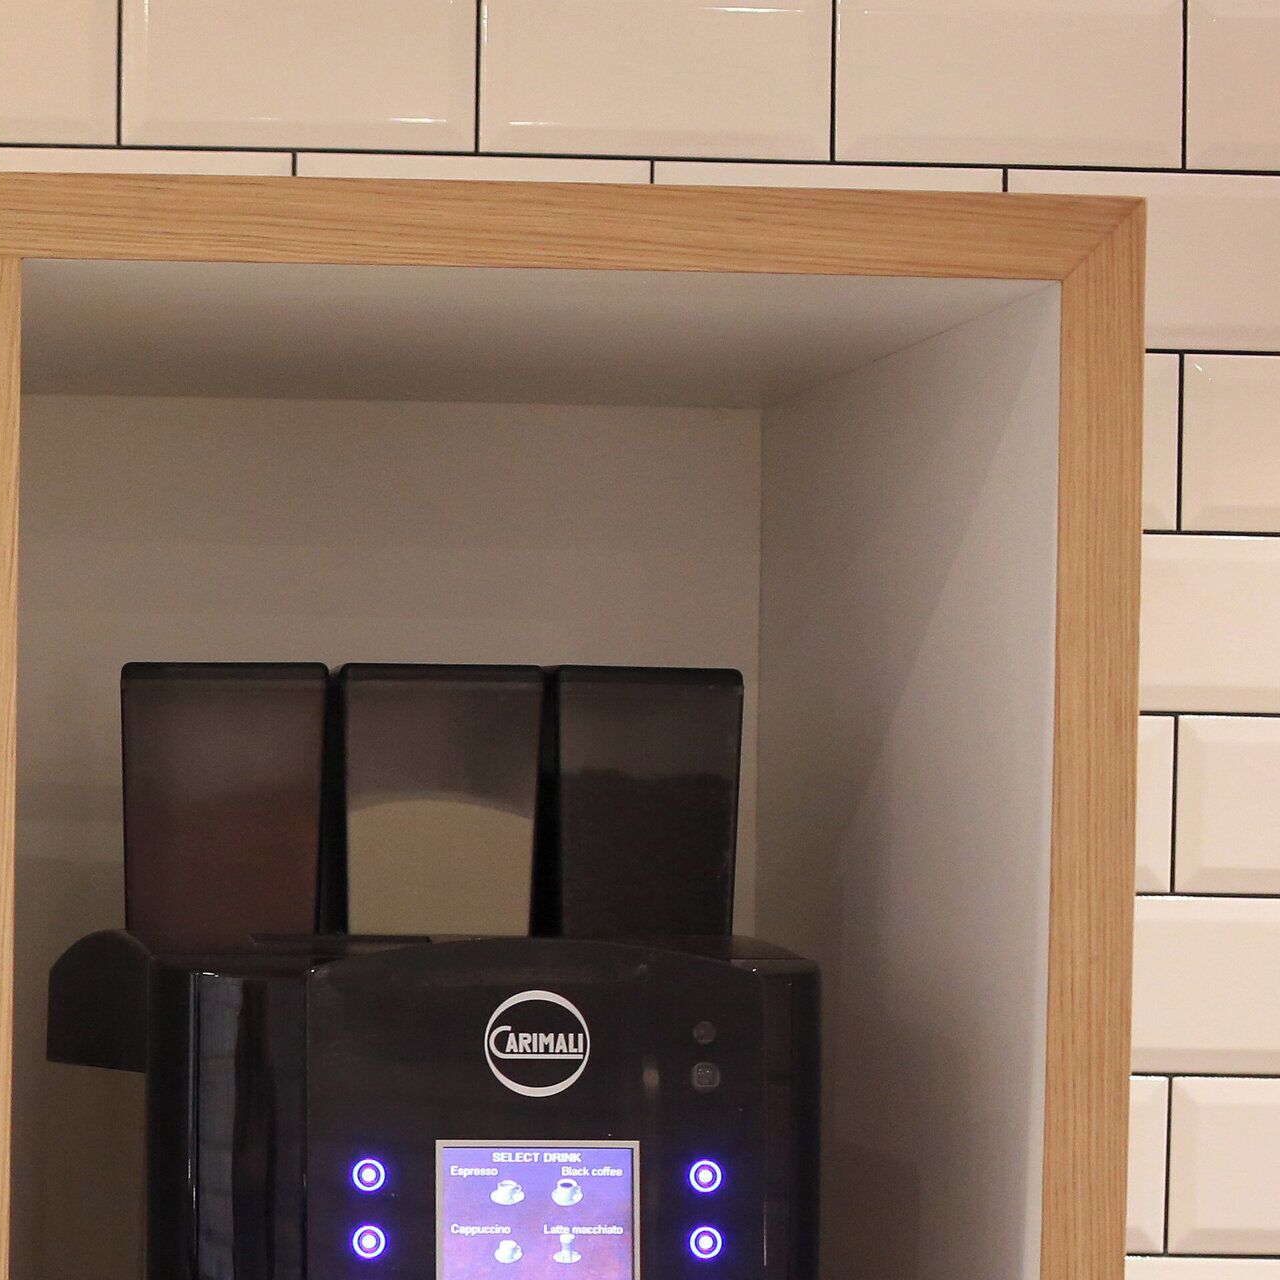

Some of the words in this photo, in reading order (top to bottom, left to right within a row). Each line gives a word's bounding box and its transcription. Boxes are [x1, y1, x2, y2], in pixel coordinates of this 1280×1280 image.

[489, 1025, 584, 1059] CARIMALI
[492, 1152, 540, 1163] SELECT
[543, 1152, 582, 1163] DRINK
[450, 1166, 499, 1177] Espresso
[561, 1166, 590, 1176] Black
[591, 1166, 623, 1177] coffee
[450, 1224, 512, 1236] Cappuccino
[543, 1224, 570, 1235] Latte
[571, 1224, 624, 1235] macchiato
